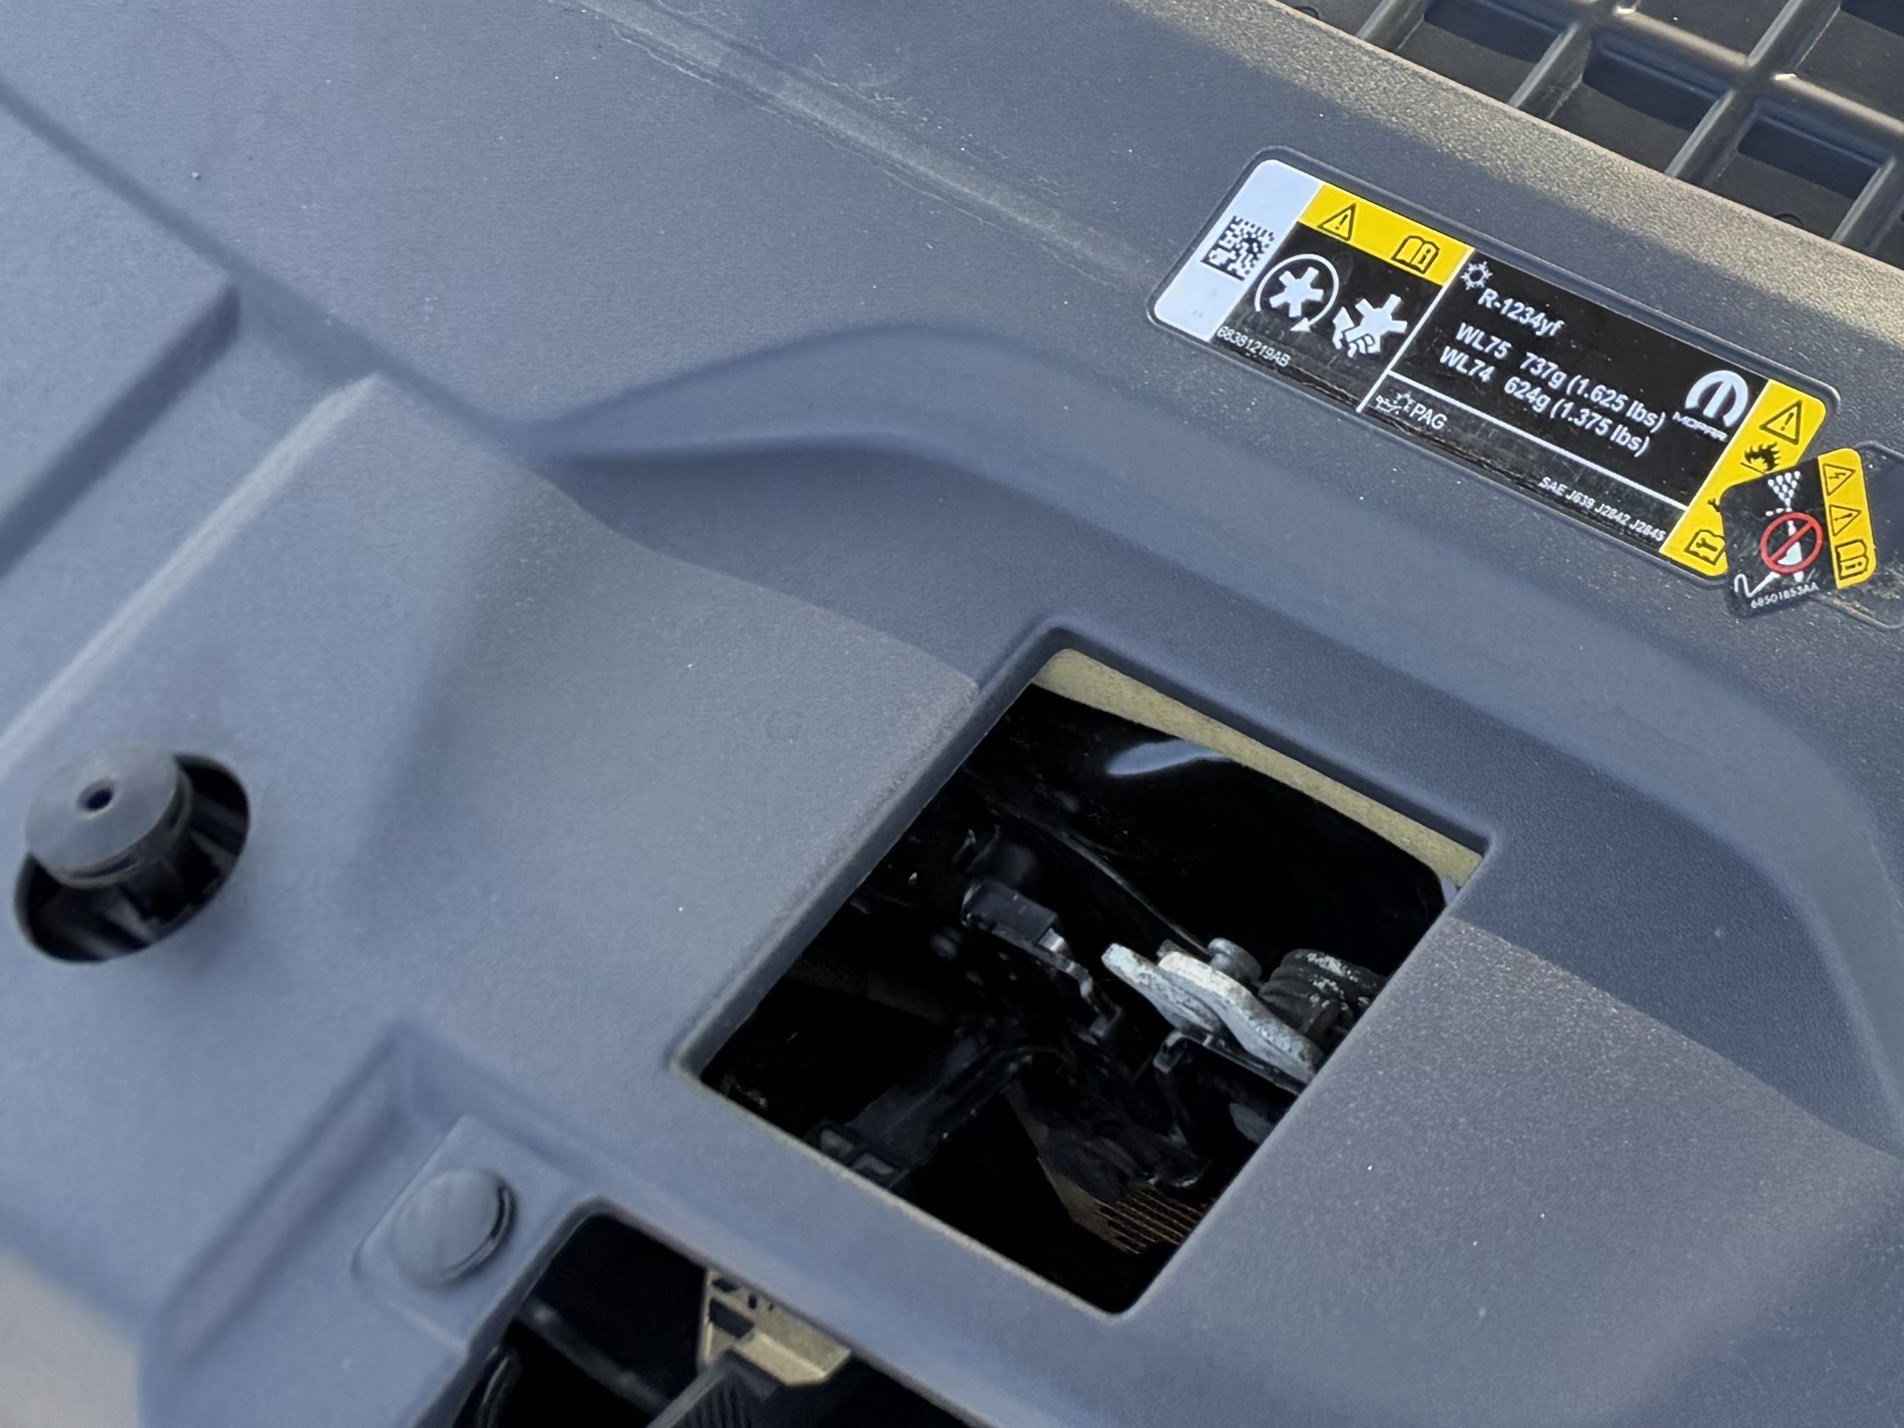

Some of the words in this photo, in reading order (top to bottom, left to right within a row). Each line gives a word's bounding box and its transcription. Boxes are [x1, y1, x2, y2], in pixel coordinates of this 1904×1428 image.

[1477, 287, 1565, 336] R-1234yf
[1439, 346, 1495, 383] WL74
[1504, 376, 1551, 413] 624g
[1550, 398, 1613, 436] (1.375
[1609, 424, 1650, 458] lbs)
[1456, 322, 1512, 359] WL75
[1519, 351, 1567, 390] 737g
[1566, 374, 1629, 412] (1.625
[1625, 400, 1666, 434] lbs)
[1409, 402, 1448, 430] PAG
[1537, 476, 1568, 496] SAE
[1565, 490, 1595, 509] J639
[1595, 503, 1631, 526] J2842
